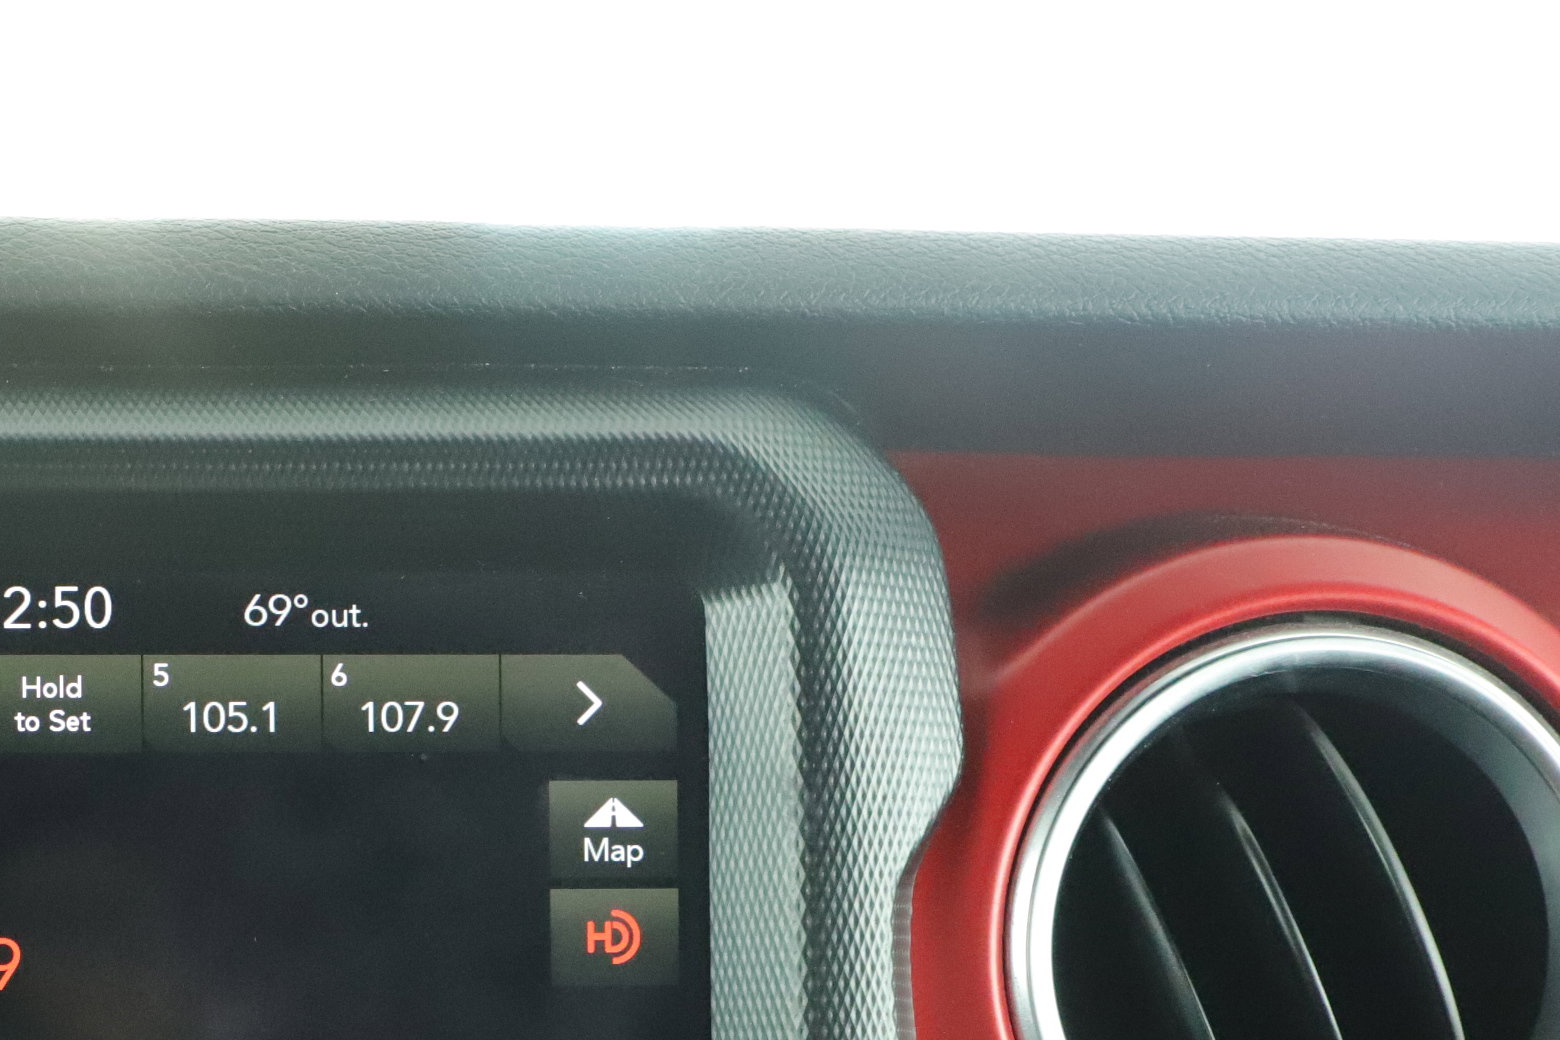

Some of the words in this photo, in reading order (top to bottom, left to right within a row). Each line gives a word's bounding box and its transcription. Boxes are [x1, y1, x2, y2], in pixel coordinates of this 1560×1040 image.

[2, 584, 113, 629] 2:50
[20, 674, 83, 700] Hold
[151, 661, 170, 688] 5
[329, 661, 349, 688] 6
[13, 711, 42, 733] to
[48, 709, 93, 733] Set
[181, 701, 278, 733] 105.1
[360, 701, 460, 733] 107.9
[582, 837, 645, 868] Map
